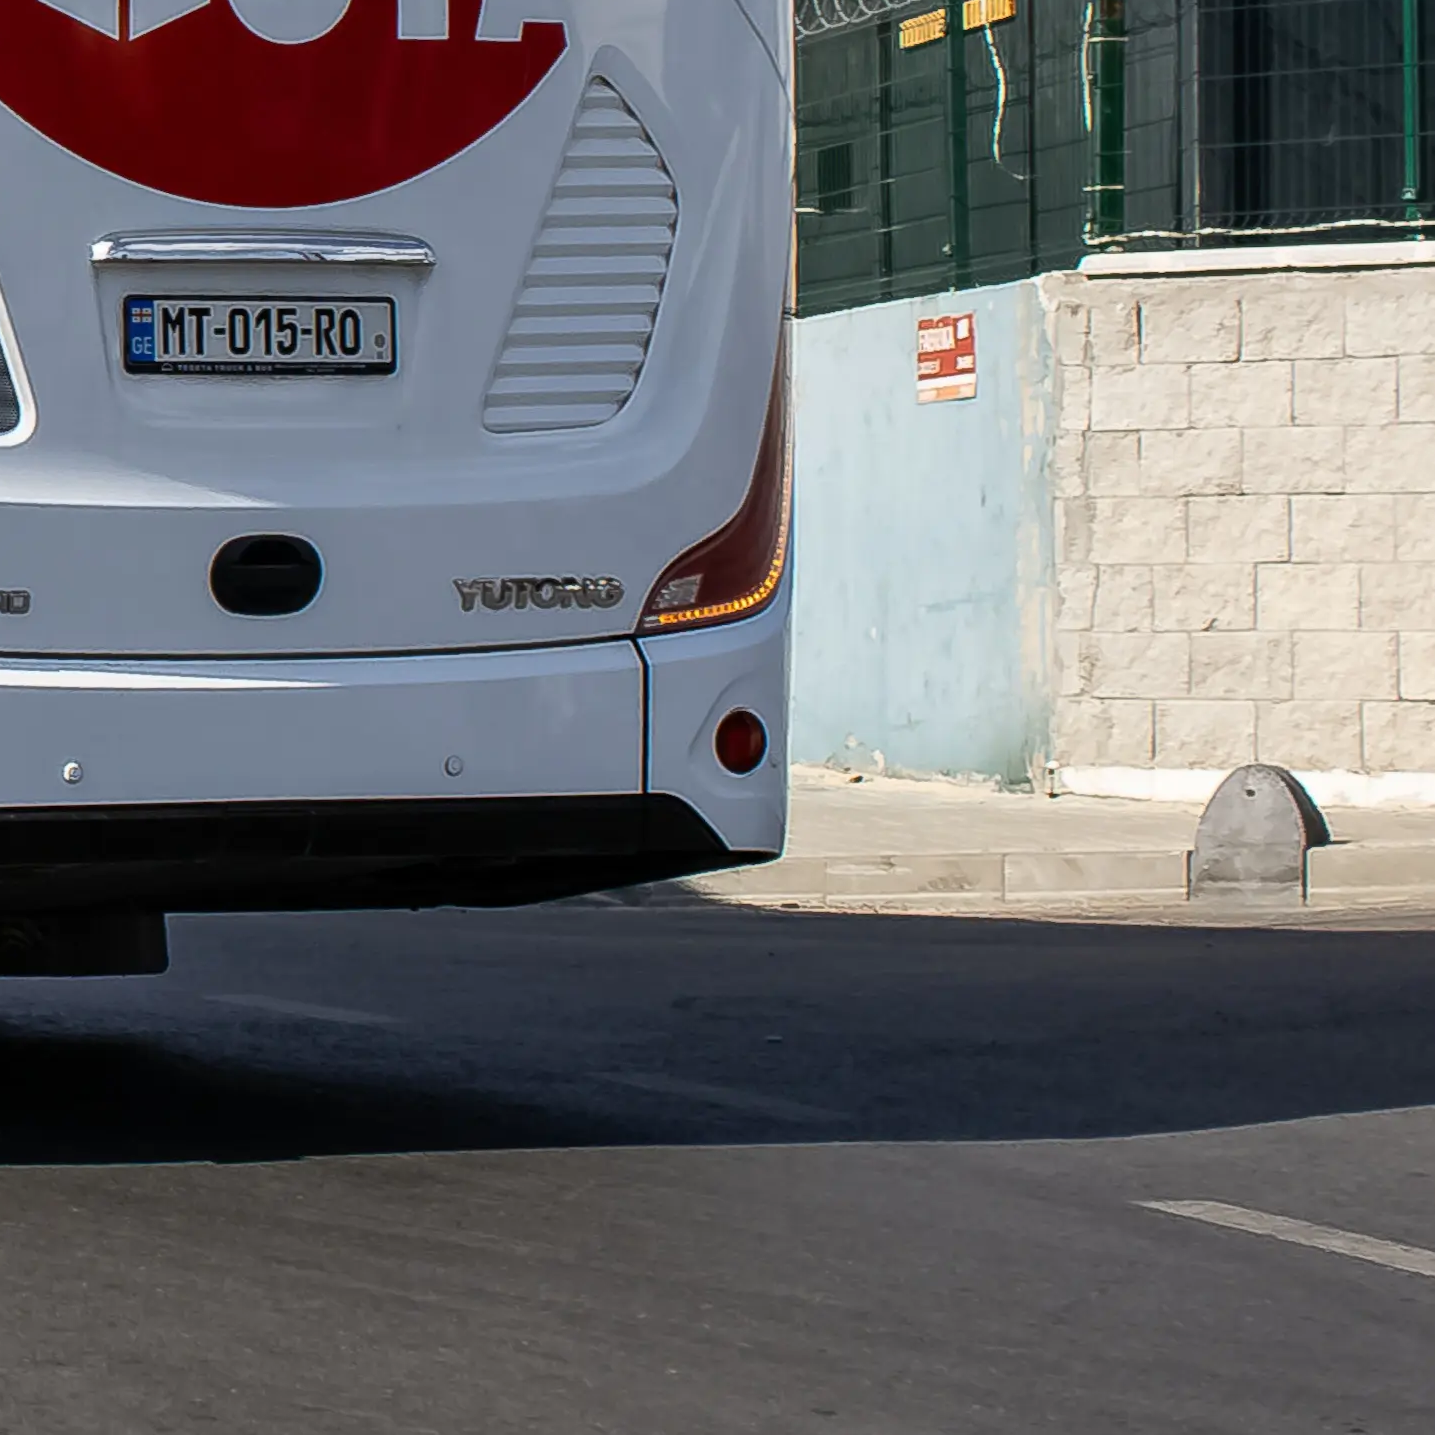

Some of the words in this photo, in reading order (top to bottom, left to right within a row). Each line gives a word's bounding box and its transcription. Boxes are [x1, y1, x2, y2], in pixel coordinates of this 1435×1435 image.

[132, 336, 153, 355] GE
[160, 307, 363, 357] MT-015-RO
[452, 575, 626, 613] YUTONG
